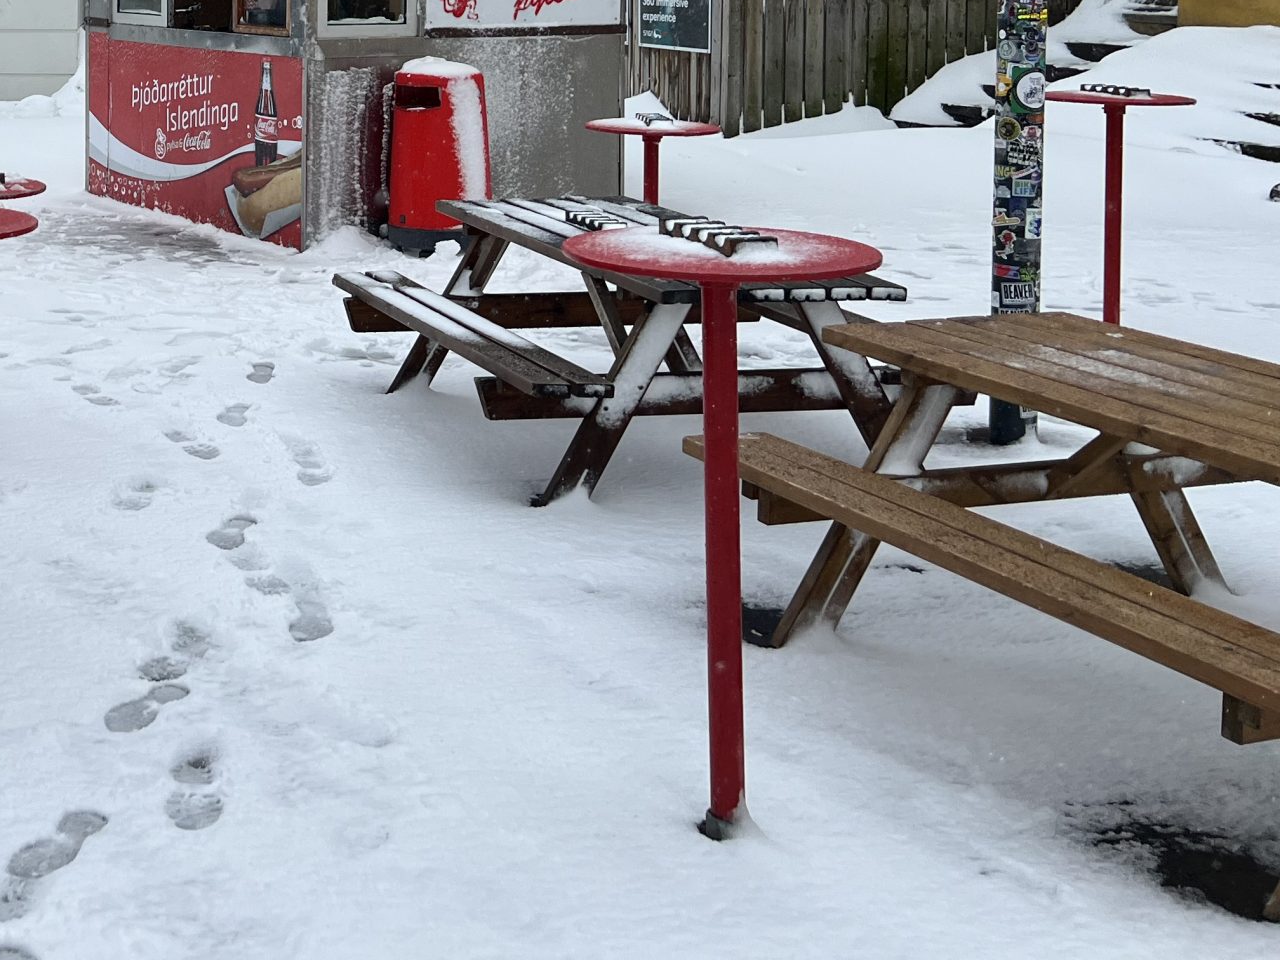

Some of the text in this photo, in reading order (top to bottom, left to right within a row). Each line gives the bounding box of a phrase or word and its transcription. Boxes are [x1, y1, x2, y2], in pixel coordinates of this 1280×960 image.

[642, 11, 677, 23] experience
[131, 73, 214, 112] Þjóðarréttur
[166, 100, 239, 132] Íslendinga
[1003, 283, 1034, 300] BEAVER
